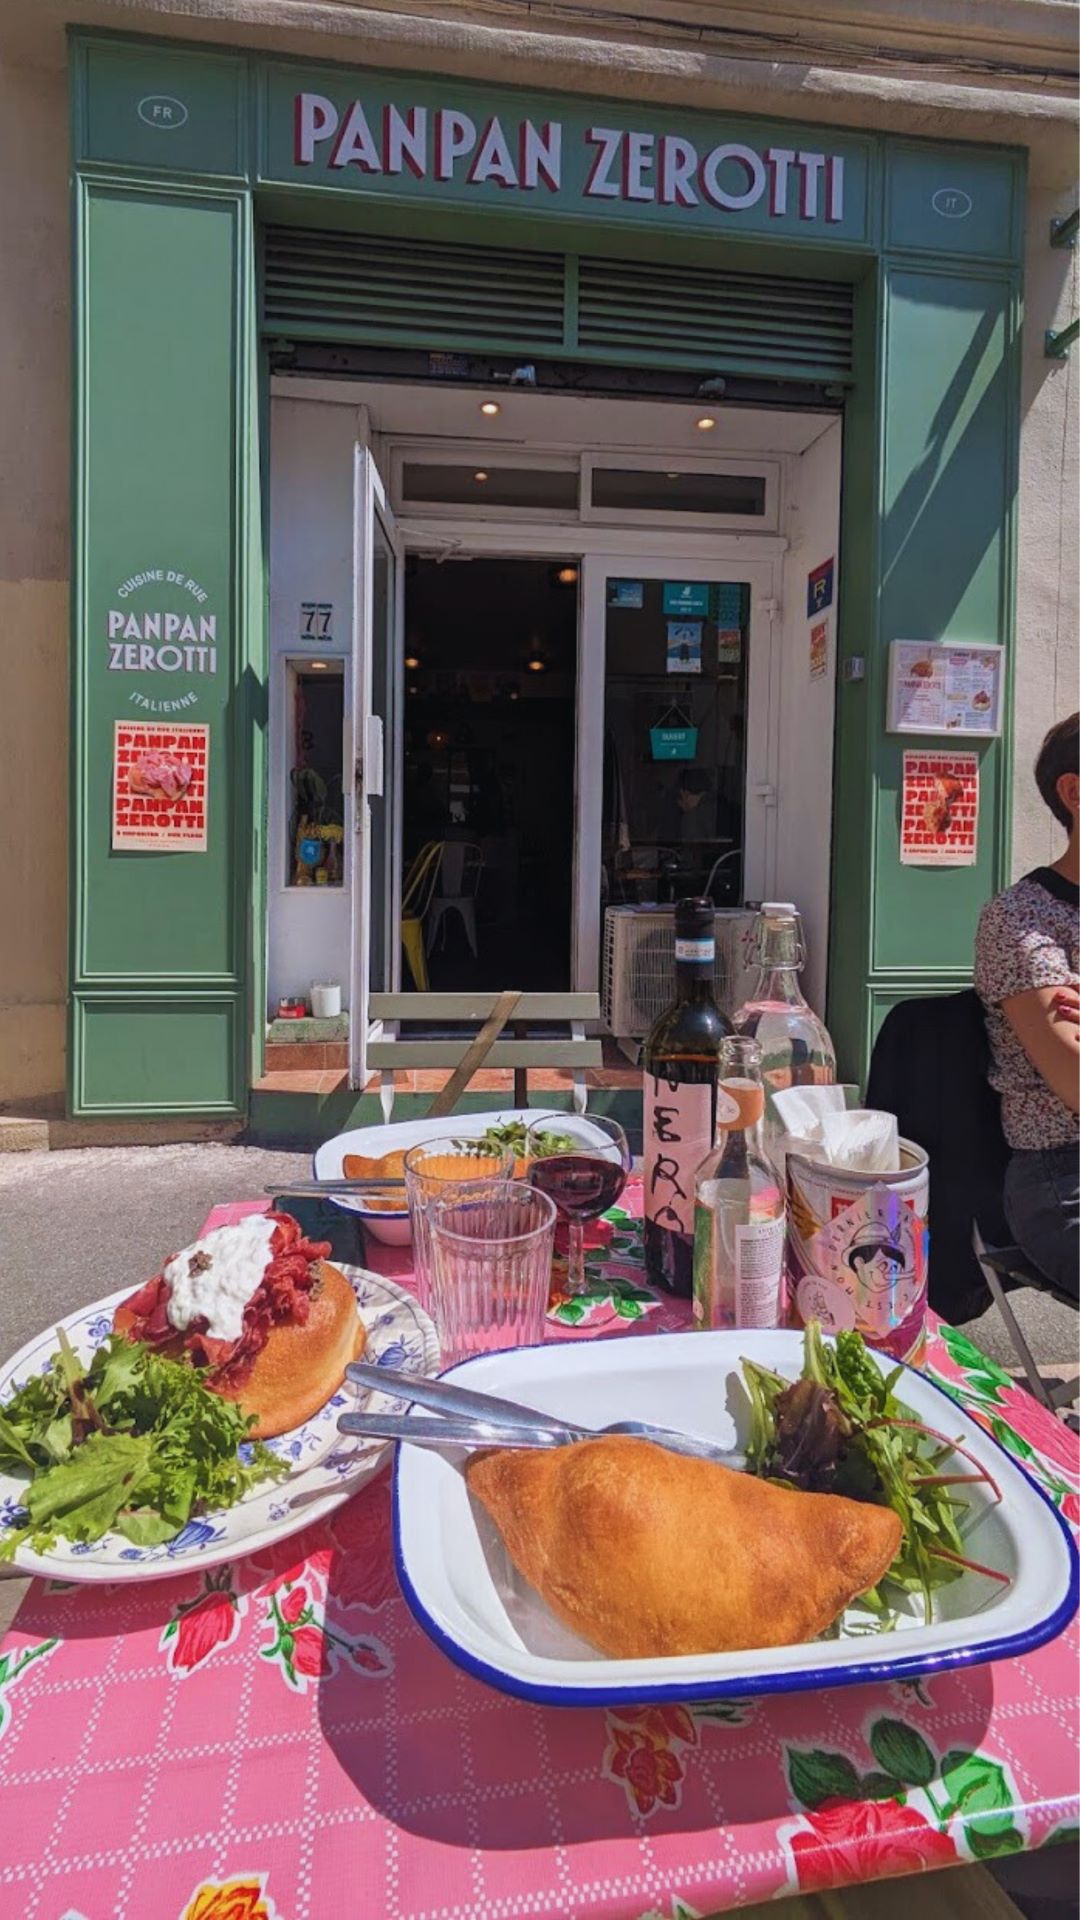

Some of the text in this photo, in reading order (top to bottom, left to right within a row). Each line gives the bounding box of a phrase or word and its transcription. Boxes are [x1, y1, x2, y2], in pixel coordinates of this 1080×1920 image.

[152, 105, 172, 119] FR
[295, 93, 844, 222] PANPAN ZEROTTI
[117, 569, 208, 603] CUISINE DE RUE
[108, 610, 216, 642] PANPAN
[302, 611, 331, 632] 77
[108, 643, 216, 674] ZEROTTI
[129, 691, 198, 712] ITALIENNE
[118, 734, 205, 749] PANPAN
[905, 761, 977, 774] PANPAN
[116, 798, 203, 813] PANPAN
[116, 813, 204, 828] ZEROTTI
[903, 832, 974, 846] ZEROTTI
